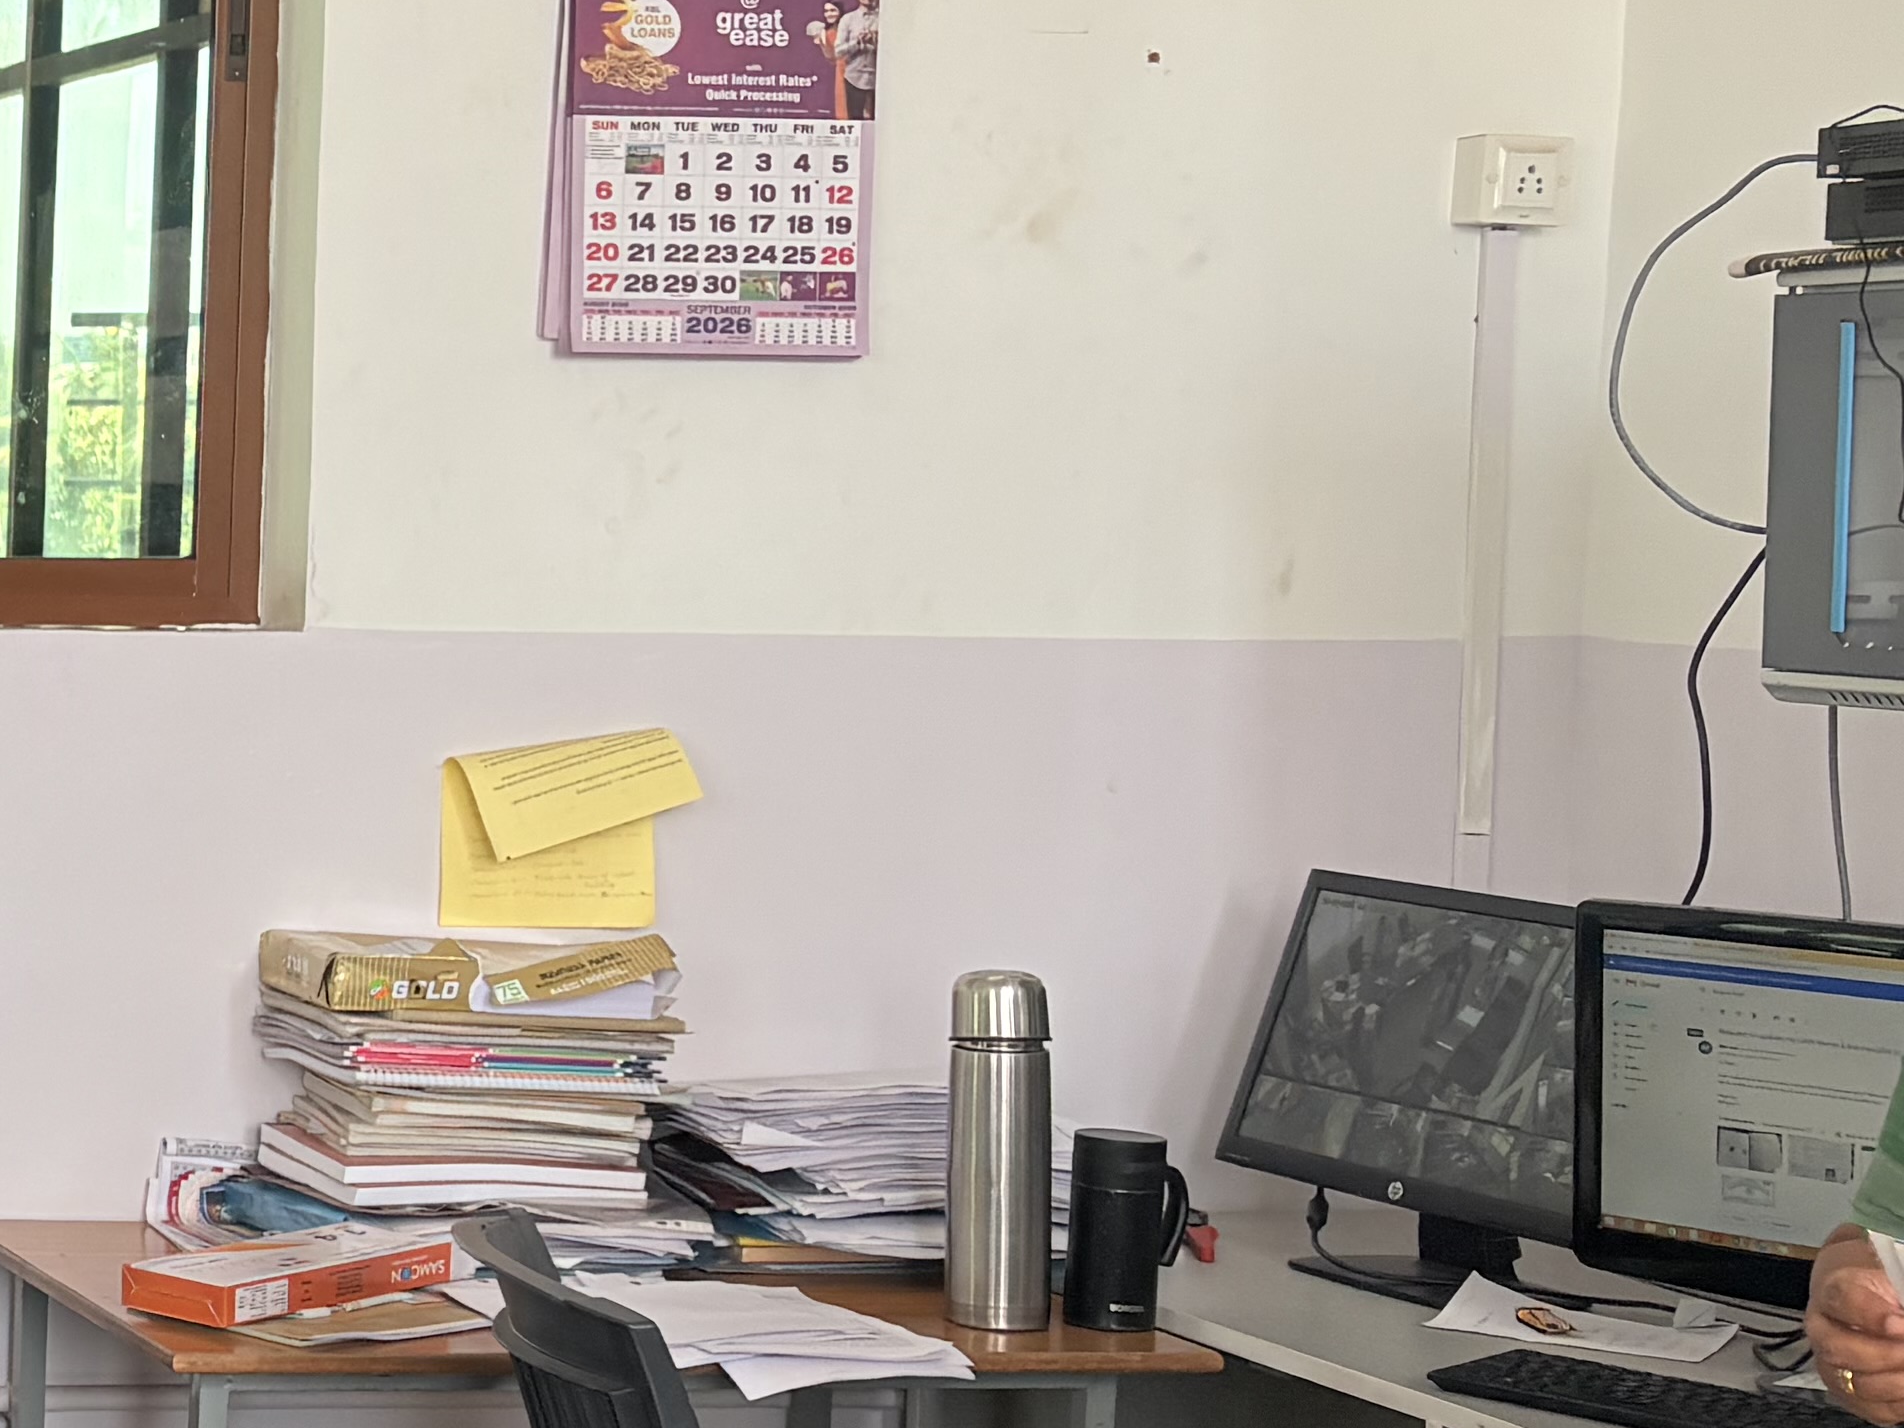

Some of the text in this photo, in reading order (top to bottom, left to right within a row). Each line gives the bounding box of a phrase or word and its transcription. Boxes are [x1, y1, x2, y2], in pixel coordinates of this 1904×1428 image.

[635, 15, 672, 25] GOLD
[716, 9, 783, 34] great
[631, 27, 675, 39] LOANS
[729, 30, 789, 47] ease
[688, 73, 728, 85] Lowest
[731, 74, 776, 86] Interest
[706, 89, 800, 104] Quick Processing
[592, 121, 854, 135] SUN MON TUE WED THU FRI SAT
[679, 152, 849, 173] 1 2 3 4 5
[595, 181, 853, 204] 6 7 8 9 10 11 12
[589, 212, 852, 235] 13 14 15 16 17 18 19
[586, 243, 854, 265] 20 21 22 23 24 25 26
[586, 273, 737, 294] 27 28 29 30
[686, 305, 751, 316] SEPTEMBER
[685, 317, 752, 334] 2026
[496, 982, 522, 1000] 75
[391, 1259, 445, 1283] SAMCON
